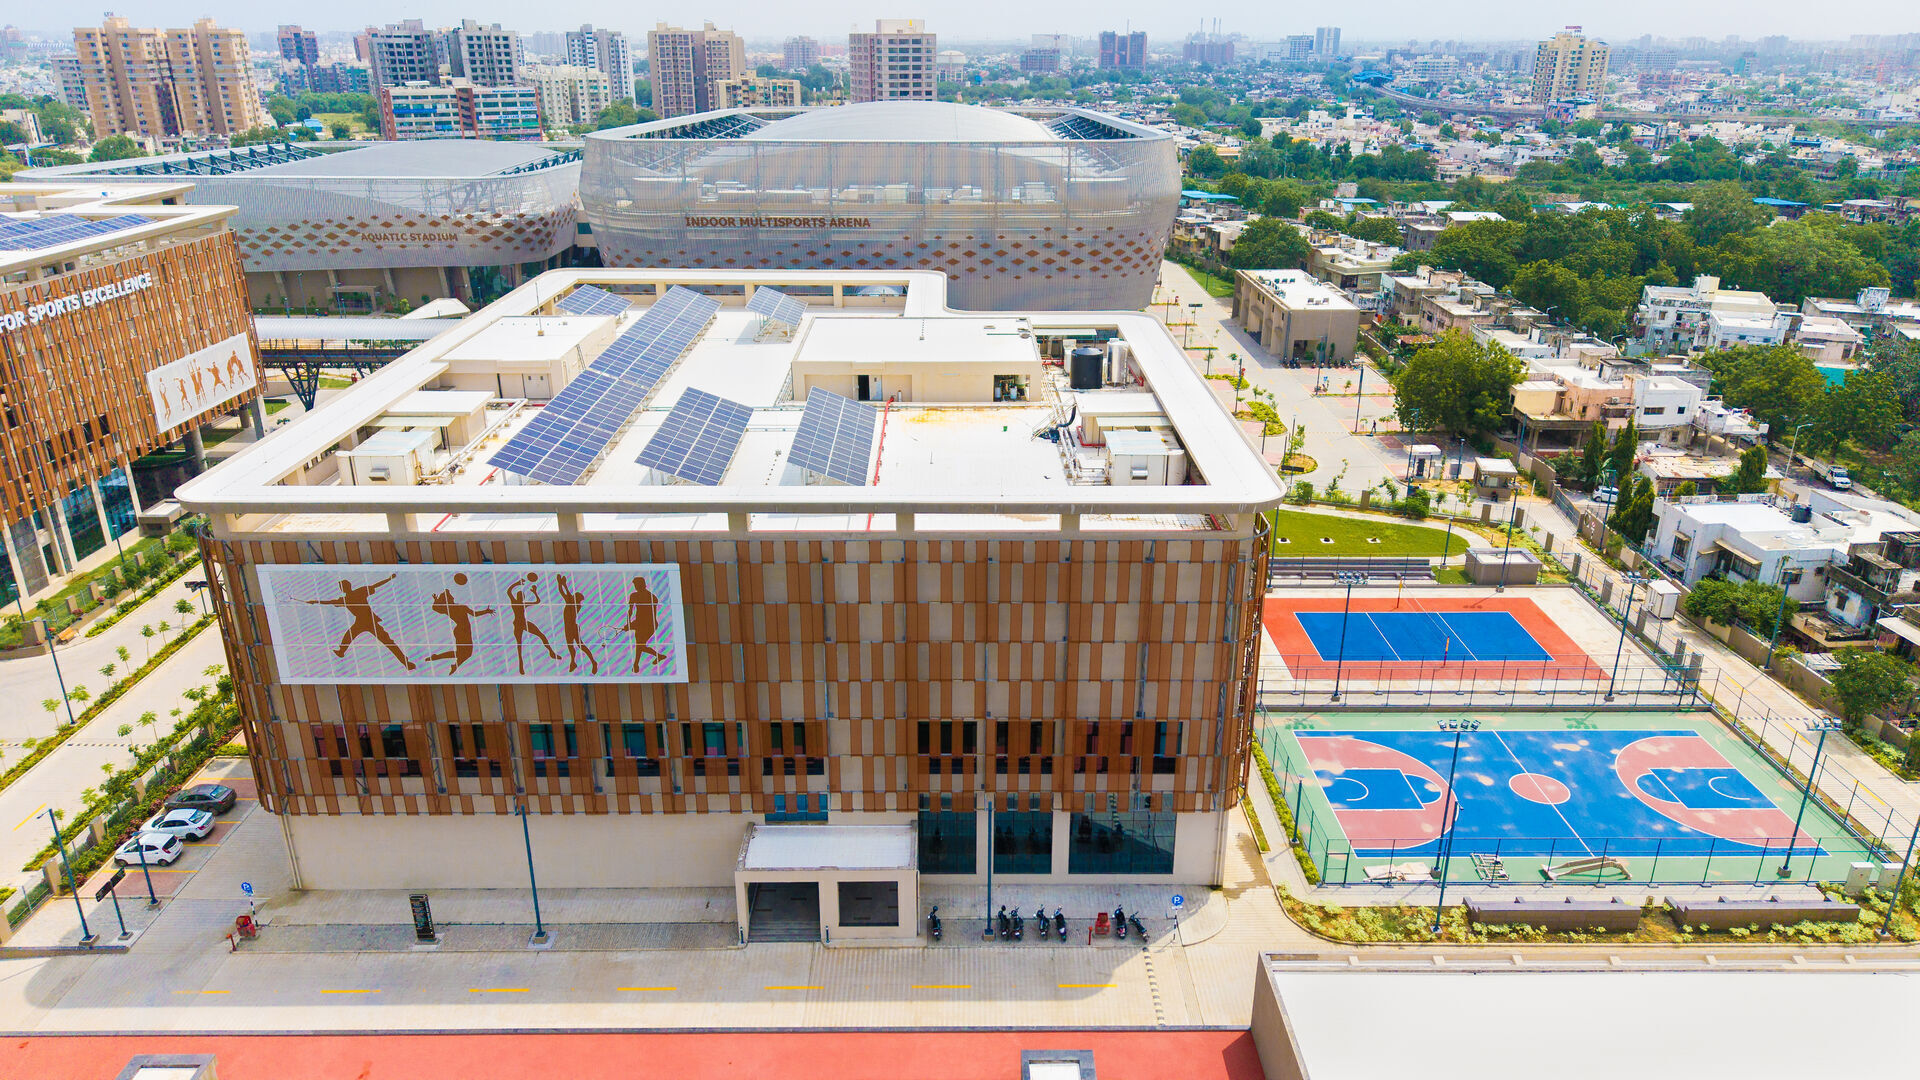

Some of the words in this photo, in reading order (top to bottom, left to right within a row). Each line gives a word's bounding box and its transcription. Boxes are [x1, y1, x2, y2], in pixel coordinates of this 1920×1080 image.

[685, 216, 736, 227] INDOOR
[739, 216, 826, 228] MULTISPORTS
[829, 217, 871, 228] ARENA
[361, 232, 408, 242] AQUATIC
[409, 232, 459, 241] STADIUM
[28, 294, 81, 324] SPORTS
[81, 272, 153, 307] EXCELLENCE
